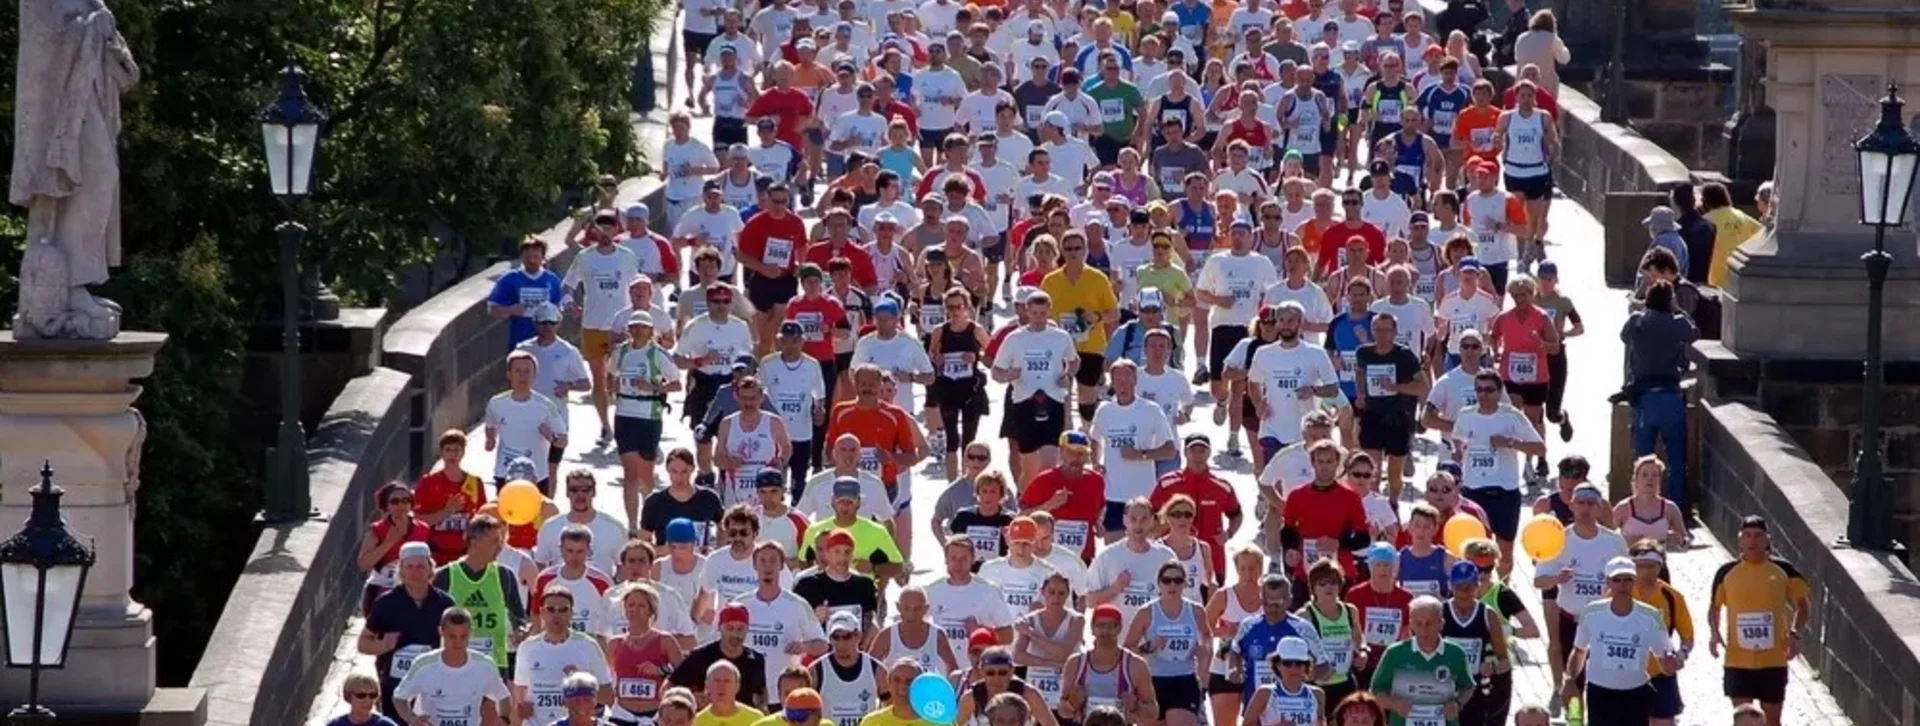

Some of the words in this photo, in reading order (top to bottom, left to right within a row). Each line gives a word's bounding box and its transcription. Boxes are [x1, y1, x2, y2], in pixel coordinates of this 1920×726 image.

[1027, 360, 1049, 371] 3522
[1575, 583, 1602, 596] 2554
[1742, 627, 1769, 640] 1304
[752, 634, 779, 647] 1409
[1168, 639, 1189, 651] 420
[1607, 645, 1637, 660] 3482
[629, 684, 651, 696] 464
[1038, 680, 1060, 692] 425
[1290, 712, 1312, 725] 264
